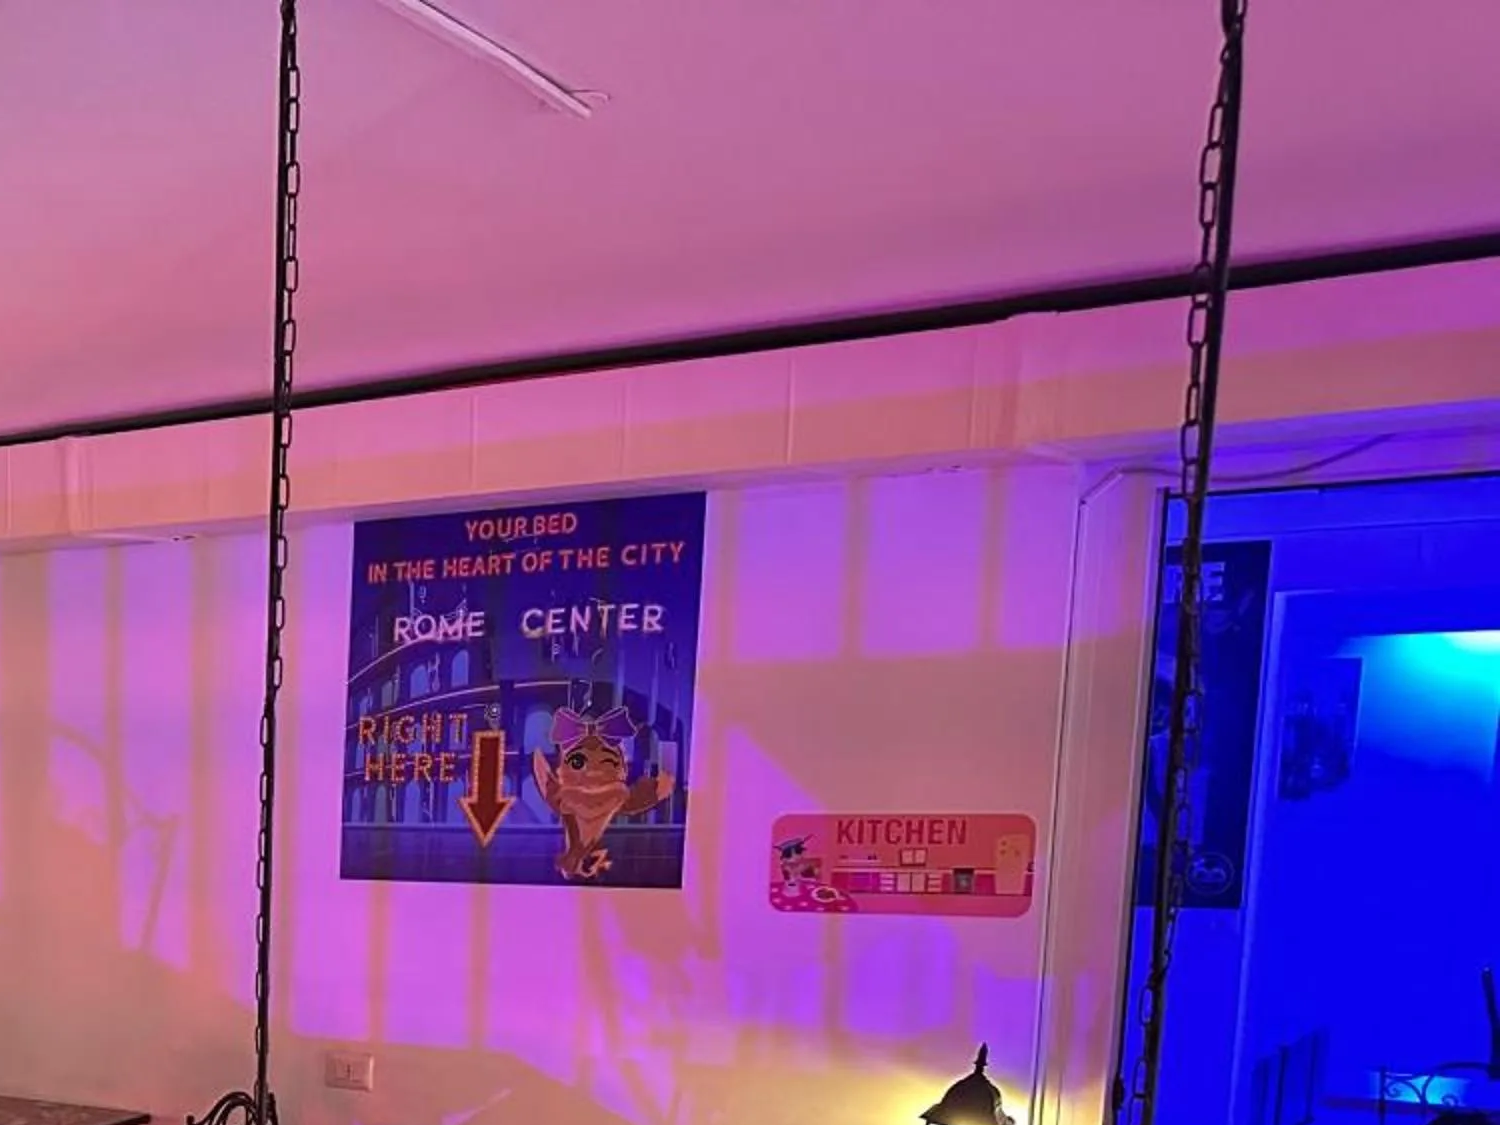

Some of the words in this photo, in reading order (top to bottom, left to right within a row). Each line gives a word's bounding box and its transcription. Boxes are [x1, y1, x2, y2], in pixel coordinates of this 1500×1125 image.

[465, 515, 527, 541] YOUR
[532, 512, 579, 536] BED
[367, 562, 387, 585] IN
[395, 557, 435, 581] THE
[443, 552, 515, 578] HEART
[521, 550, 553, 573] OF
[559, 545, 610, 569] THE
[620, 541, 686, 566] CITY
[393, 610, 485, 643] ROME
[520, 603, 666, 634] CENTER
[357, 712, 468, 746] RIGHT
[364, 752, 456, 783] HERE
[836, 818, 968, 846] KITCHEN
